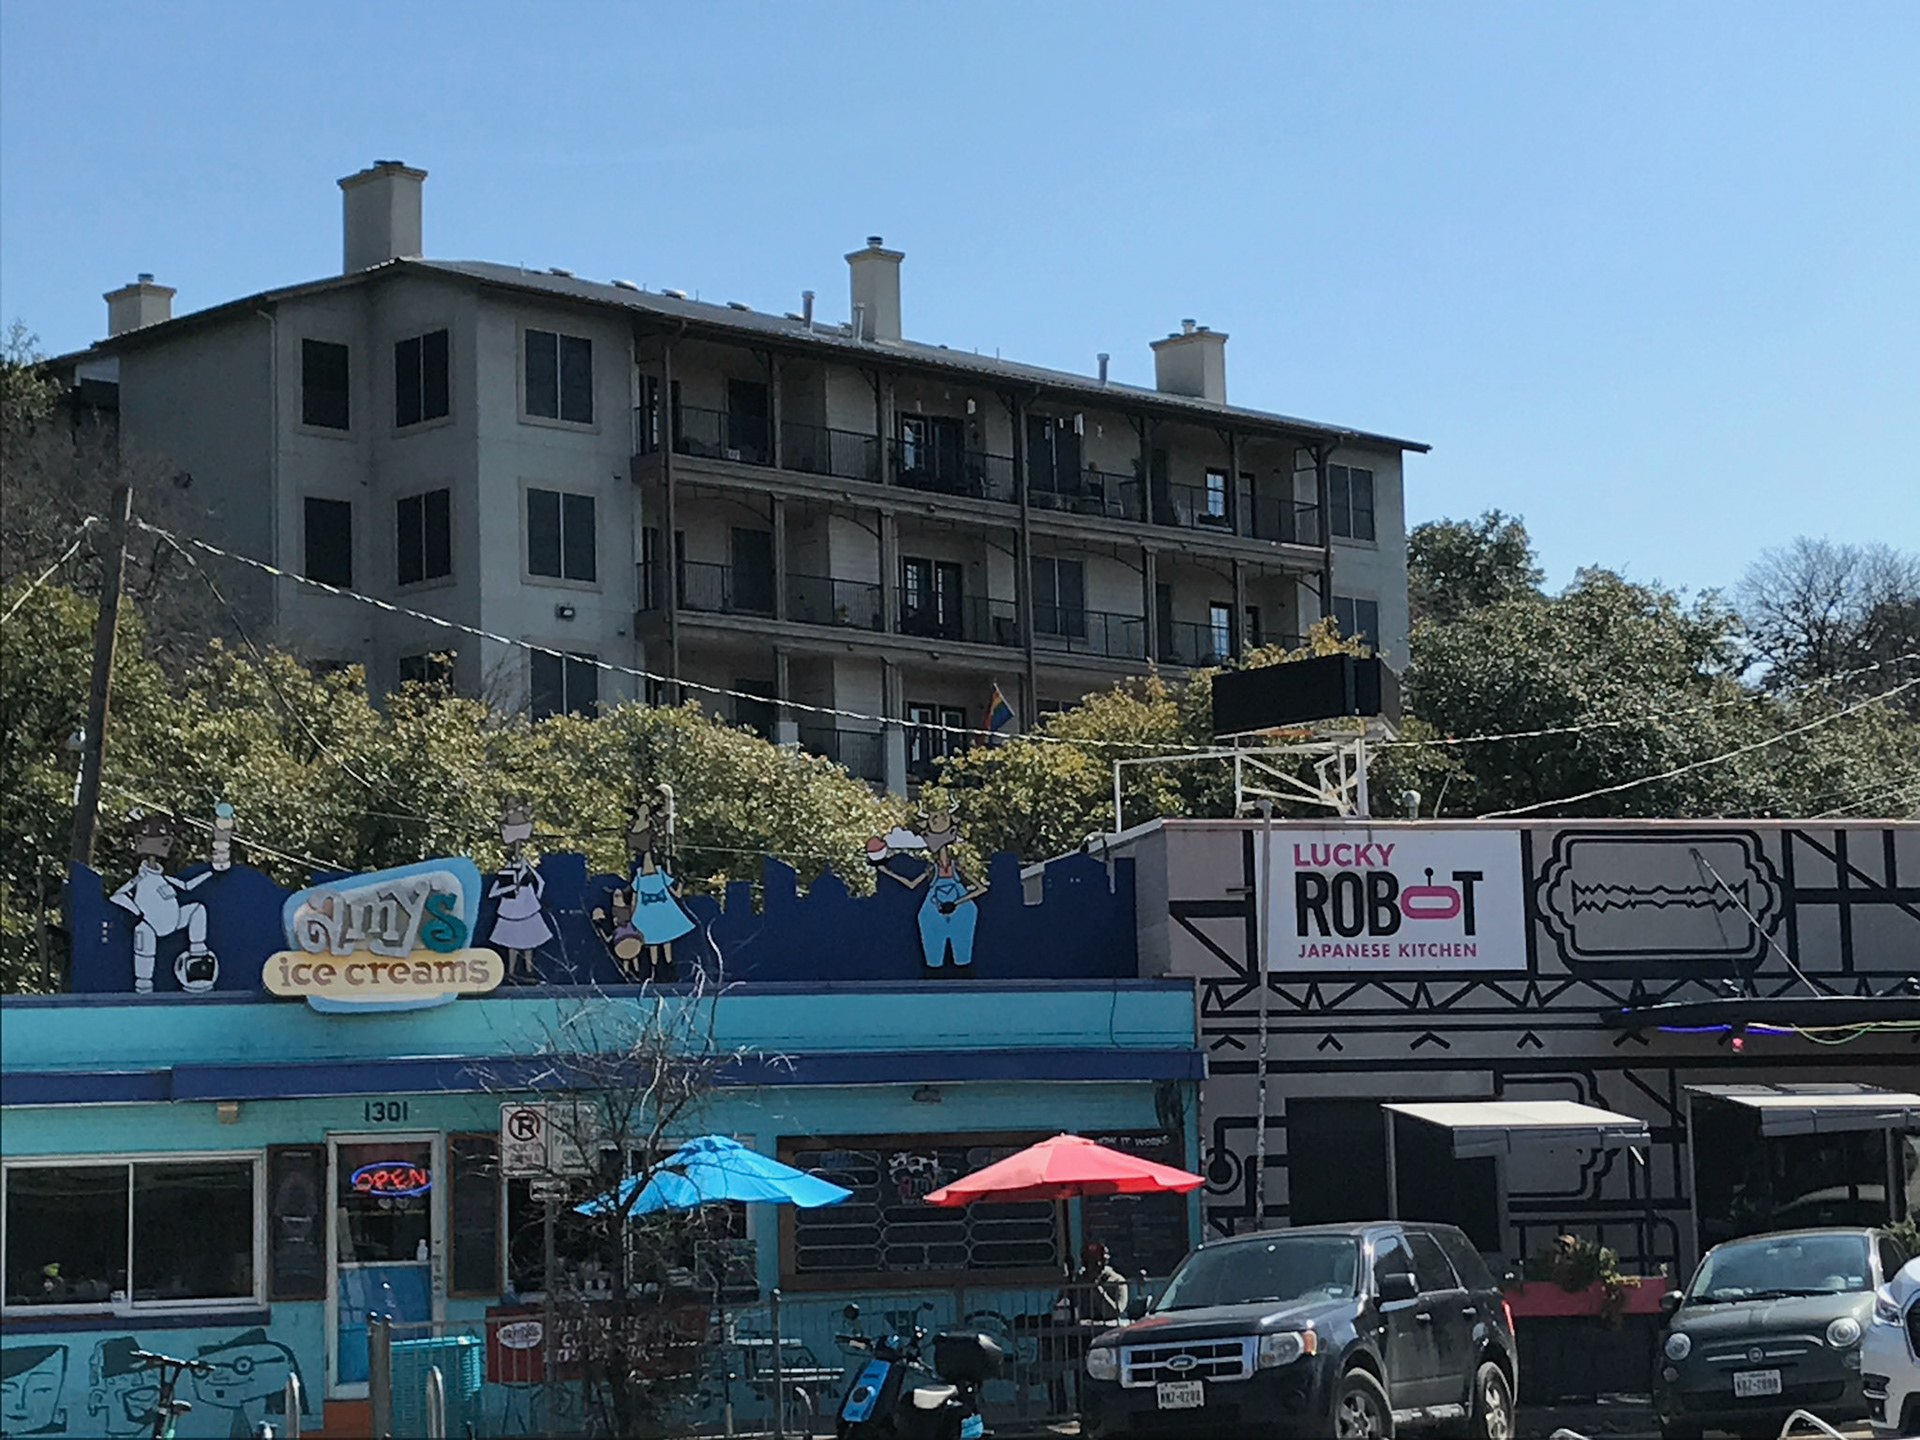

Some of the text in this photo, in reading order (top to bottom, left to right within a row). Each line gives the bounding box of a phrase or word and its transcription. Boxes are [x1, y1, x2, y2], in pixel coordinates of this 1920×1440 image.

[1294, 843, 1395, 867] LUCKY
[1295, 868, 1483, 938] ROBOT
[1298, 943, 1477, 958] JAPANESE KITCHEN
[279, 956, 490, 987] ice creams
[364, 1101, 408, 1121] 1301
[355, 1168, 427, 1193] OPEN
